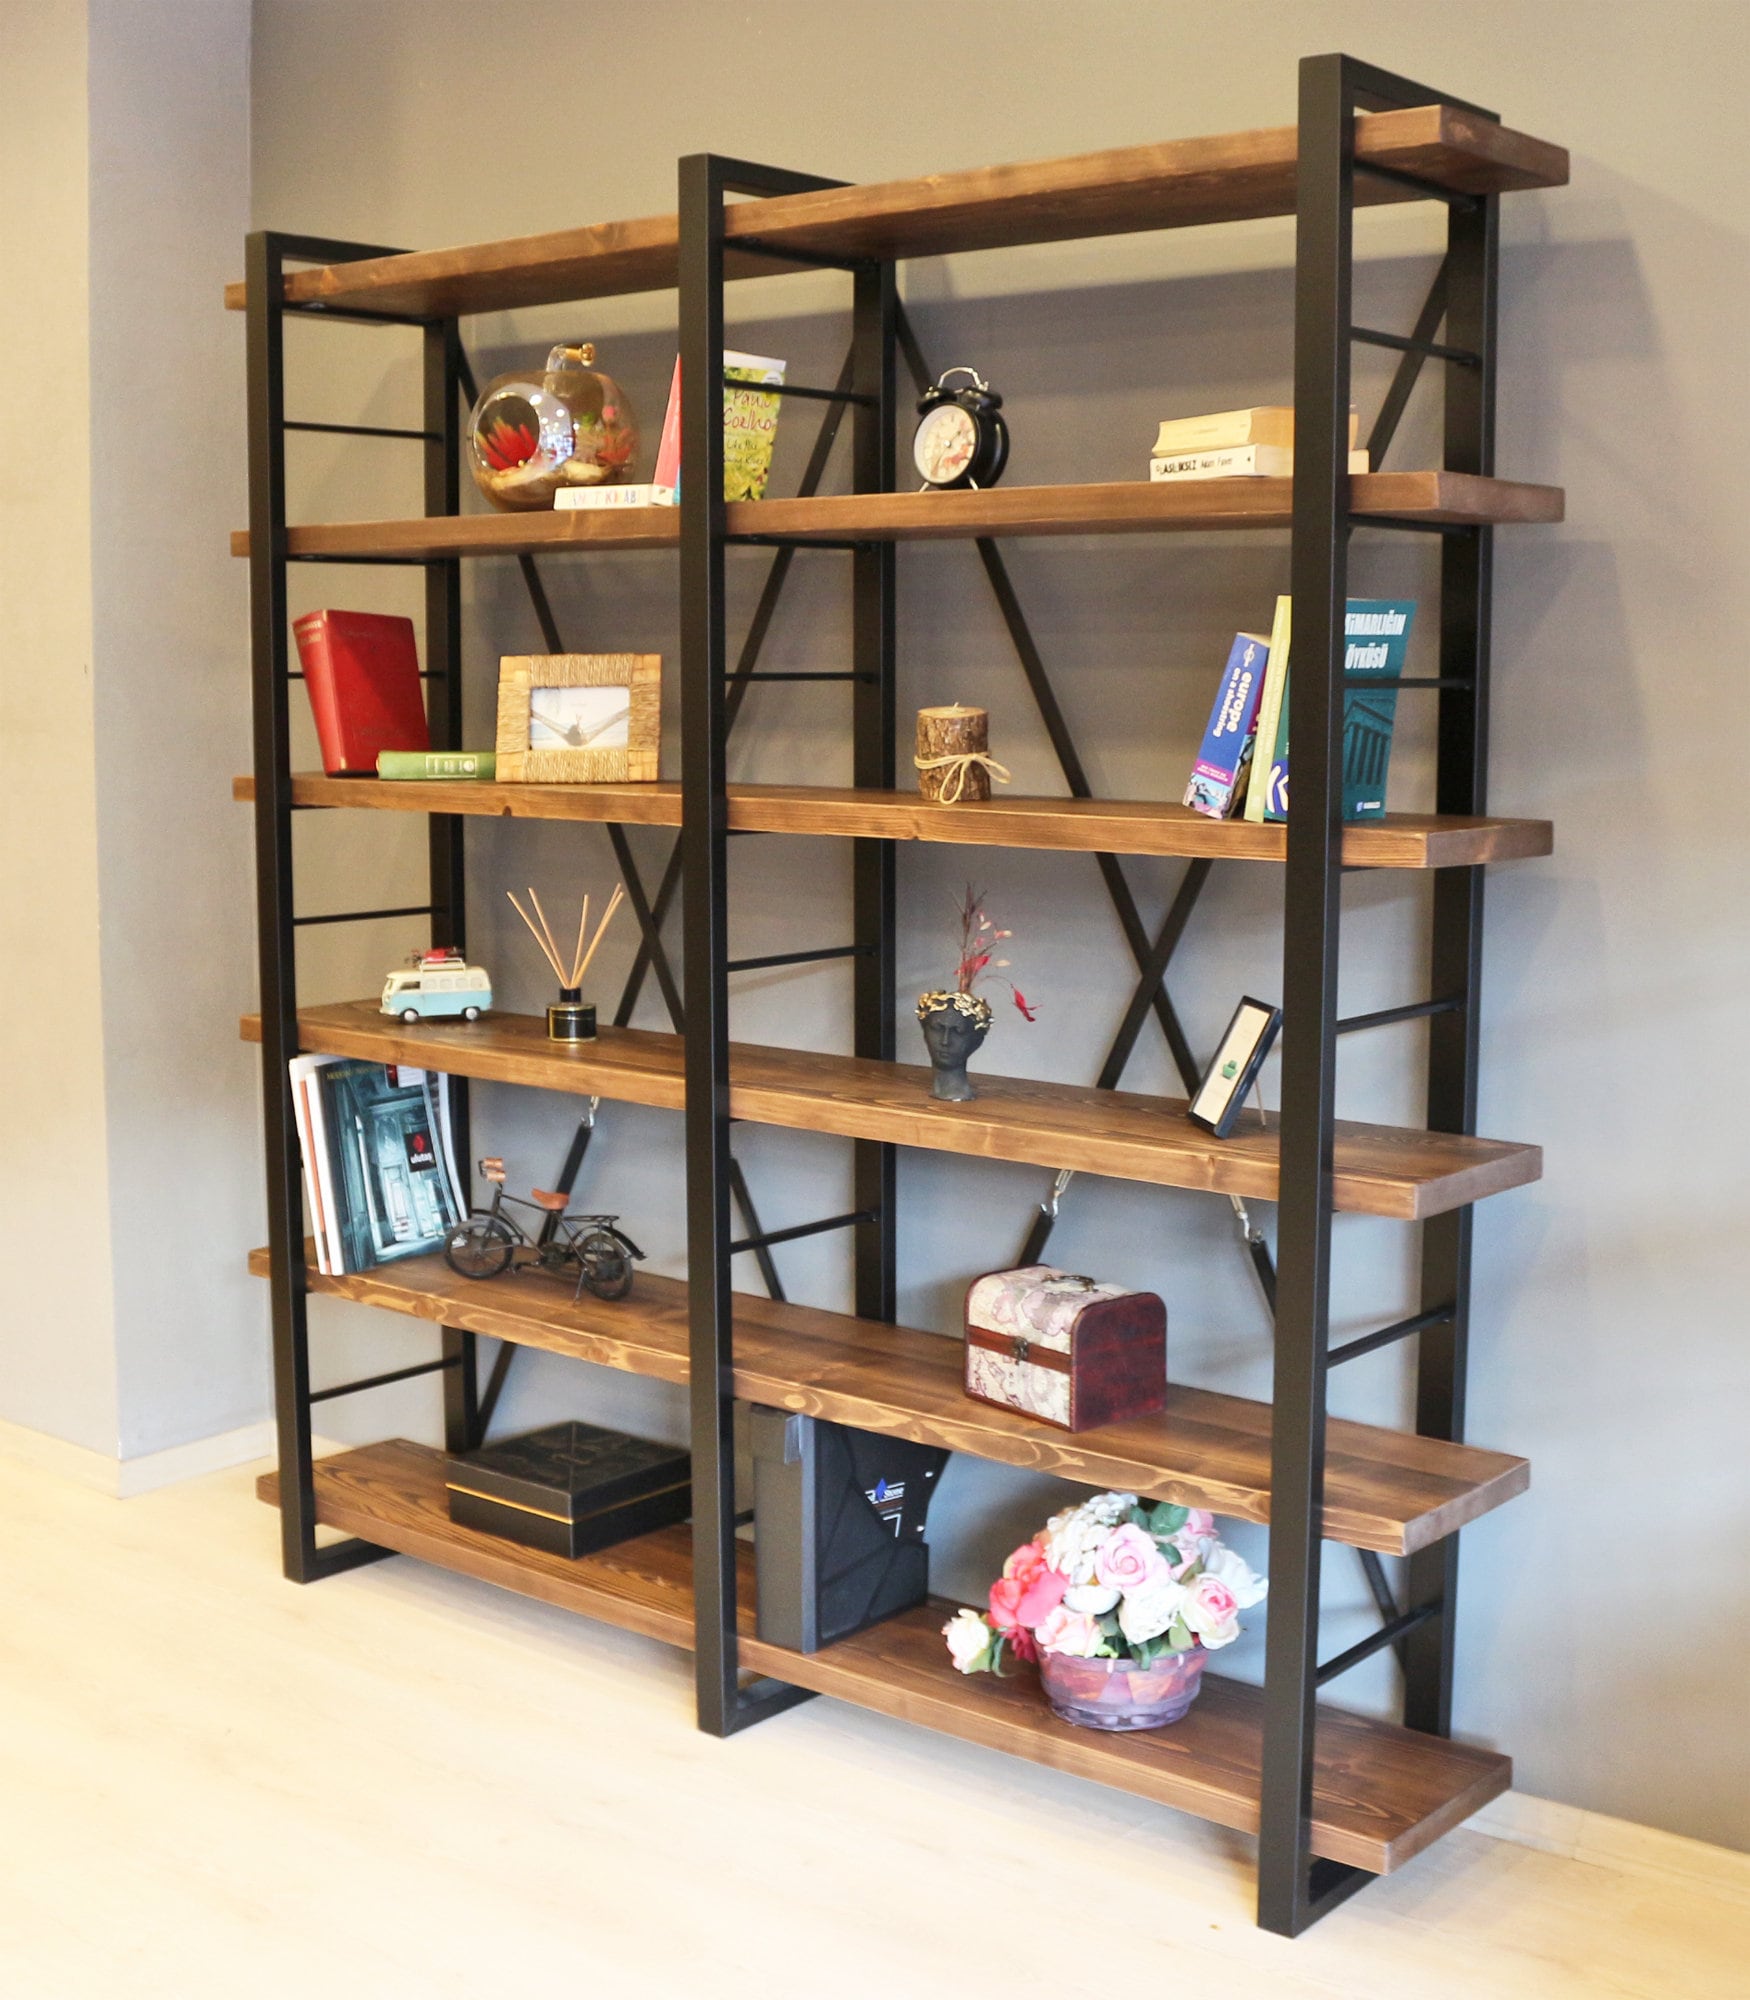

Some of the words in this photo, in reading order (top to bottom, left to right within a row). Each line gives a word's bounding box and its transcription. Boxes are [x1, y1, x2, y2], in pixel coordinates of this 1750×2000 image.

[724, 407, 772, 431] Coelho
[1344, 642, 1389, 670] ÖYKÜSÜ
[1226, 671, 1253, 733] europe
